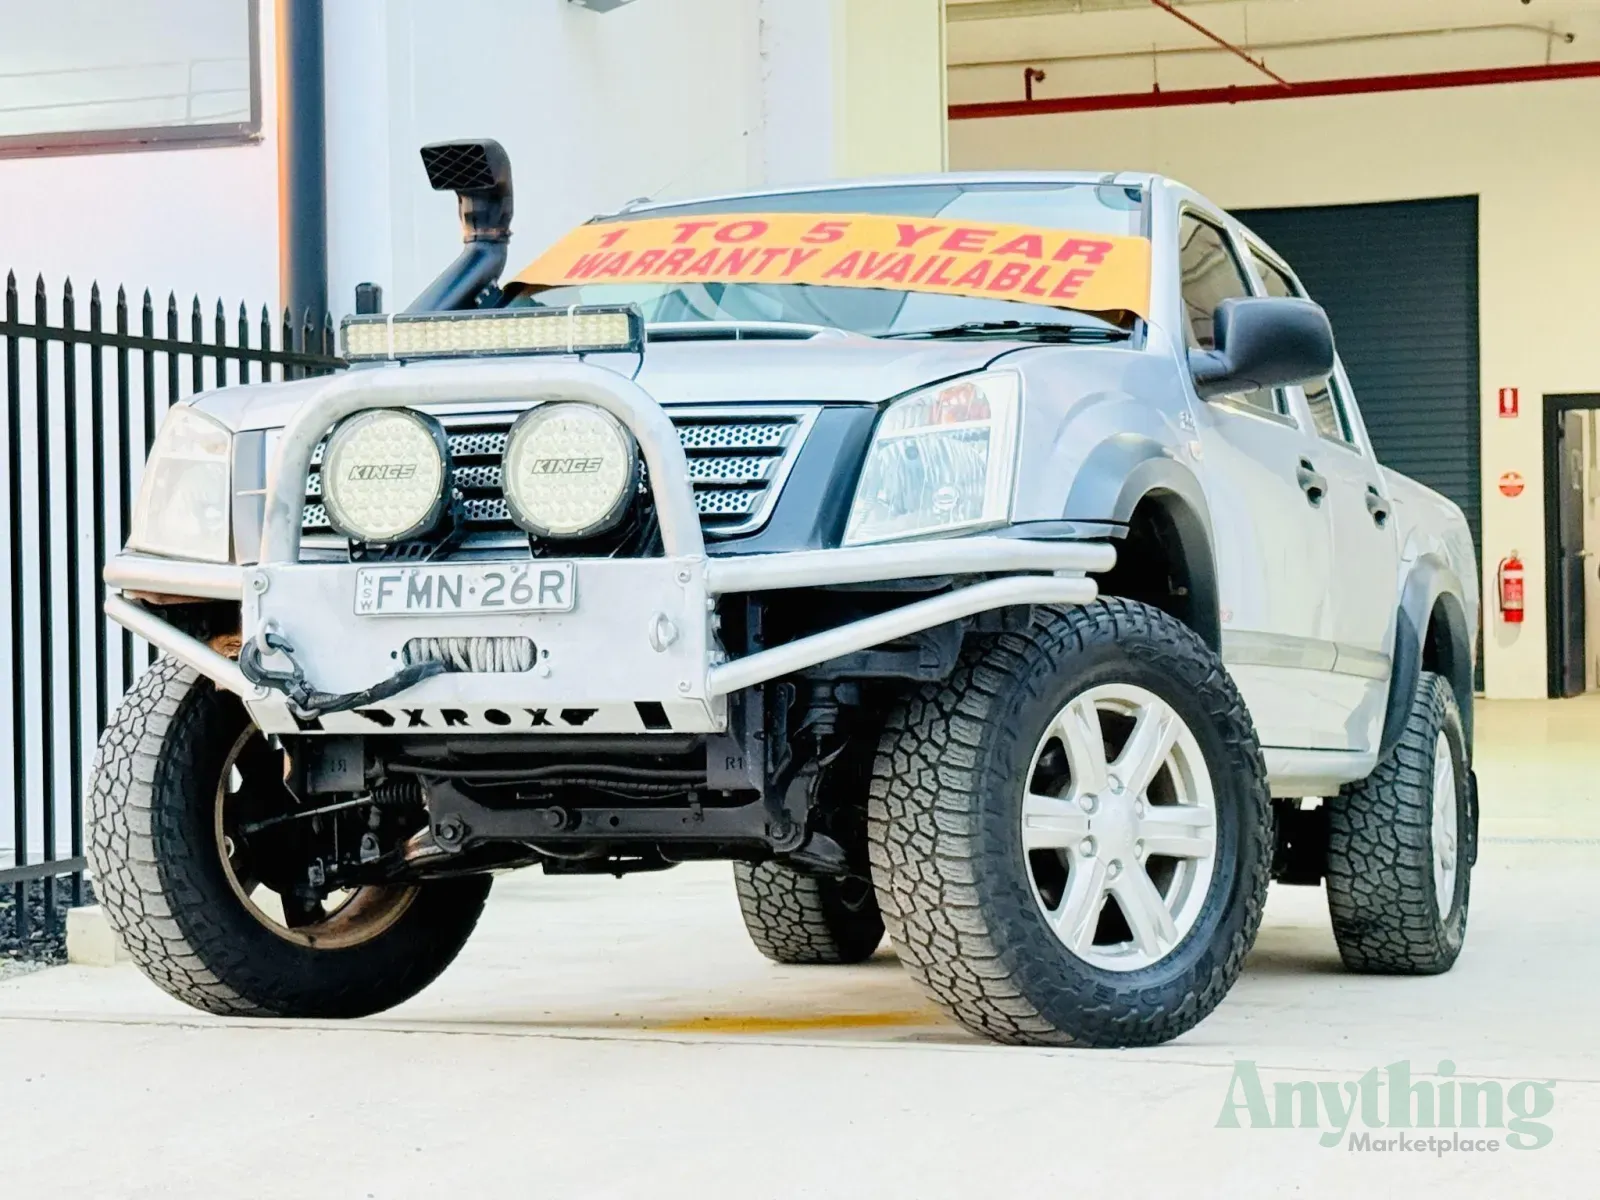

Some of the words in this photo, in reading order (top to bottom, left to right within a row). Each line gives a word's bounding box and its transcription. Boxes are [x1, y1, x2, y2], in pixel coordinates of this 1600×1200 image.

[598, 227, 629, 248] 1
[671, 220, 769, 244] TO
[800, 221, 853, 244] 5
[895, 223, 1114, 265] YEAR
[563, 247, 822, 279] WARRANTY
[821, 249, 1095, 299] AVAILABLE
[348, 463, 417, 481] KINGS
[531, 457, 603, 475] KINGS
[400, 707, 556, 728] XROX
